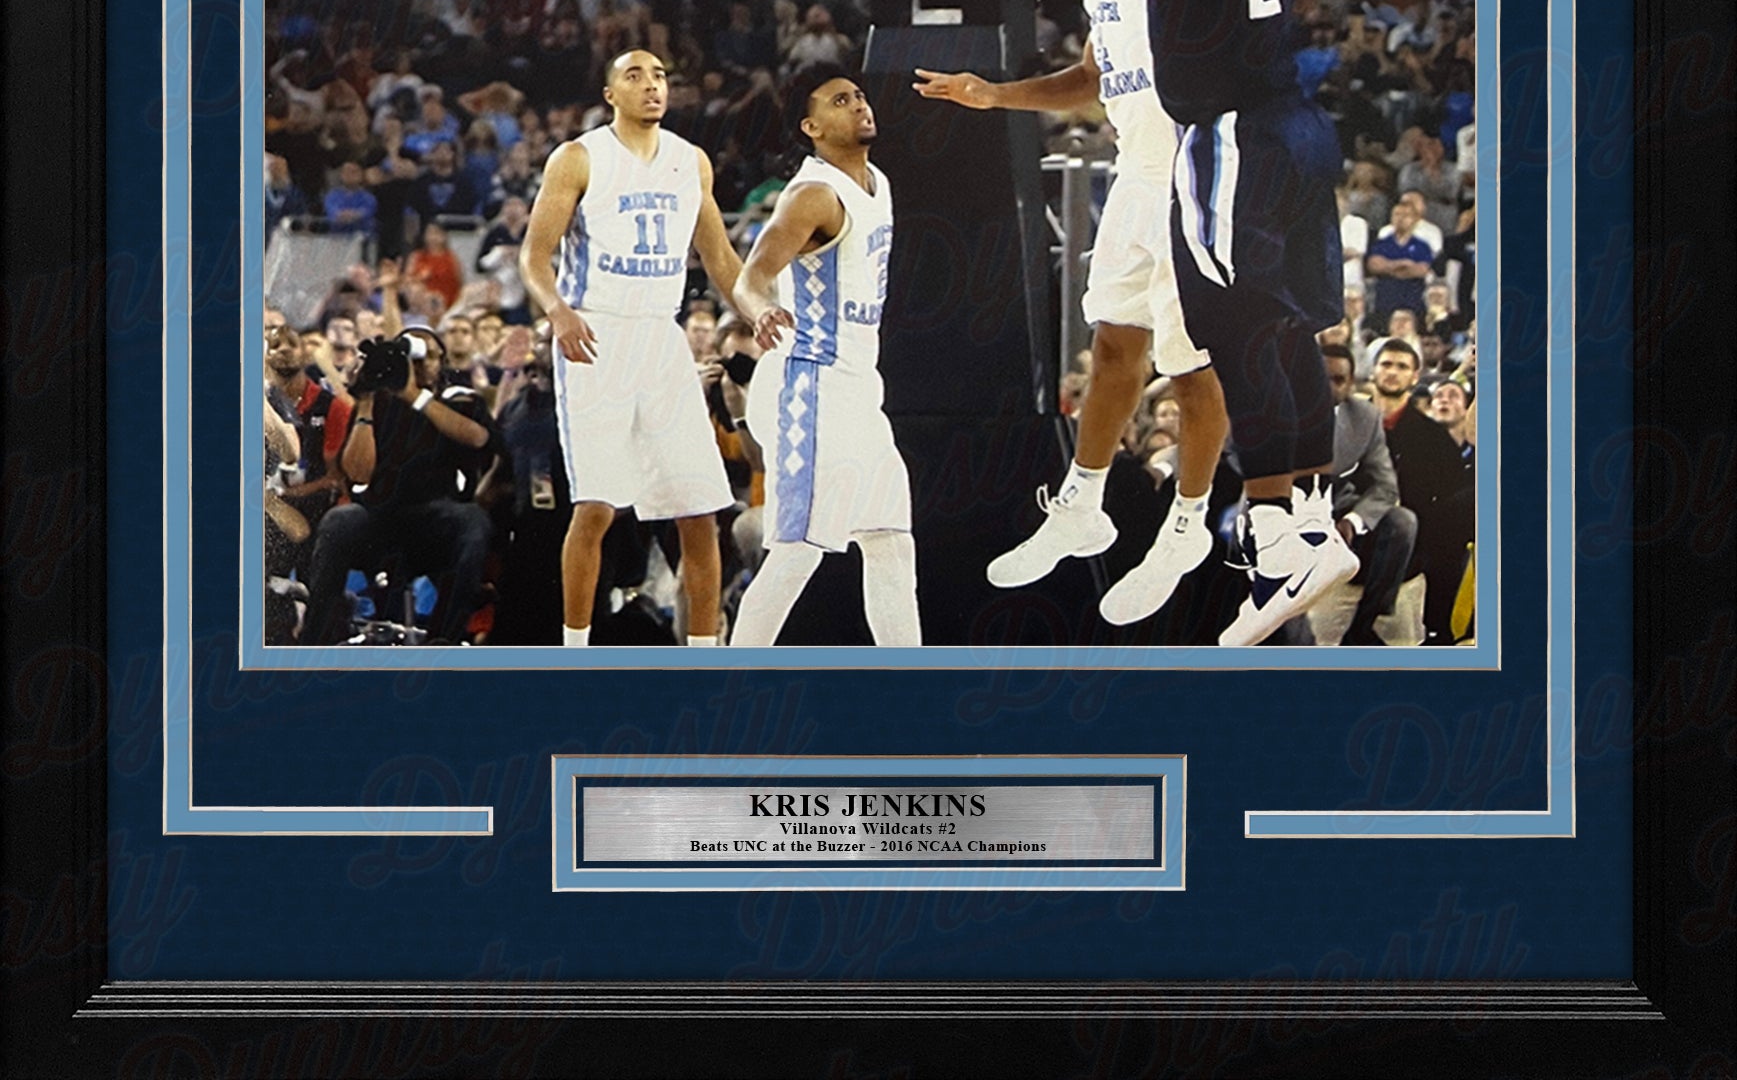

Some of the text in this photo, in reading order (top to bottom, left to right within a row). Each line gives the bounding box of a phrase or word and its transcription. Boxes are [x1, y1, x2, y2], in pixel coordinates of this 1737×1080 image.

[633, 214, 668, 255] 11
[749, 794, 986, 817] KRIS JENKINS
[779, 822, 957, 835] Villanova Wildcats #2
[690, 840, 728, 853] Beats
[733, 840, 768, 853] UNC
[772, 841, 788, 853] at
[791, 840, 812, 853] the
[817, 840, 866, 853] Buzzer
[880, 840, 913, 853] 2016
[917, 840, 963, 853] NCAA
[967, 840, 1047, 856] Champions
